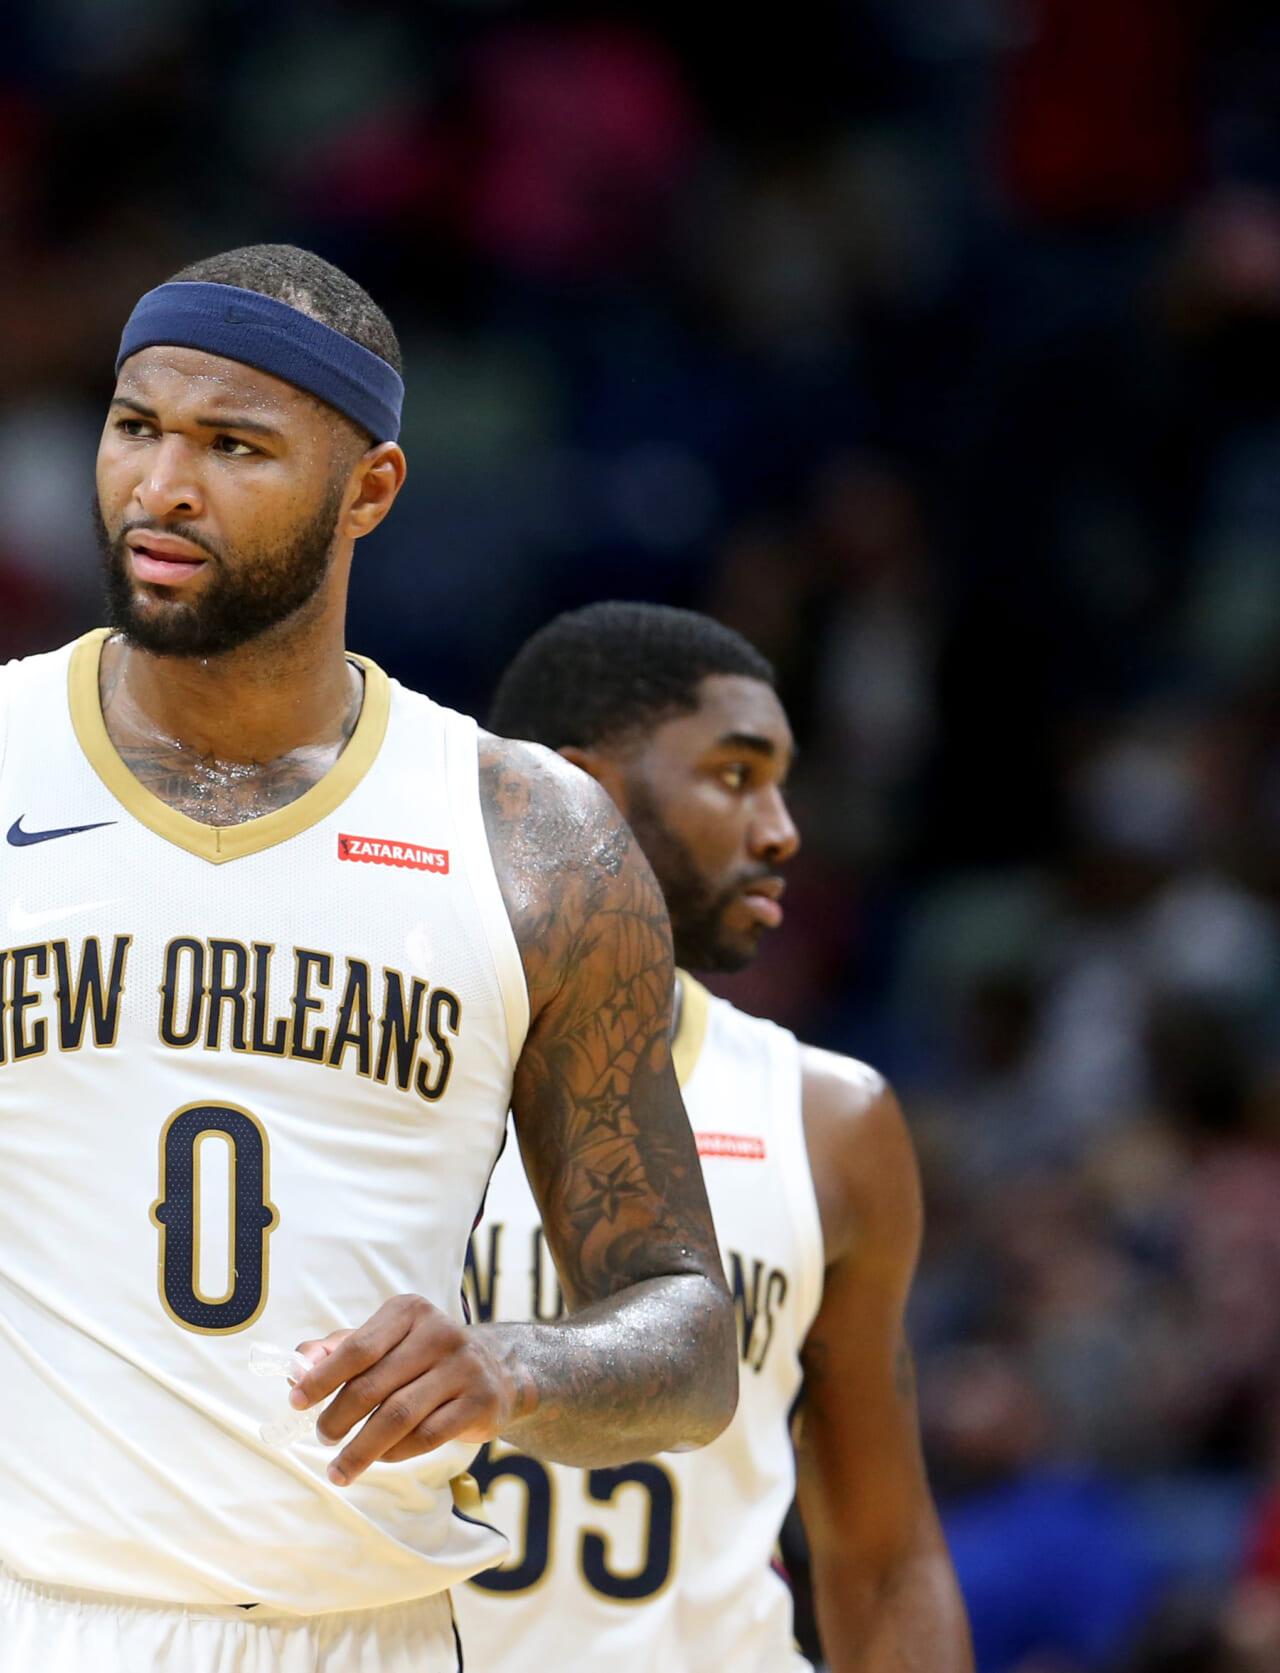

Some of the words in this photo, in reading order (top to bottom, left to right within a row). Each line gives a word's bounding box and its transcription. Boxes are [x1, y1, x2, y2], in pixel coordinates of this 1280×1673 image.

[349, 840, 446, 867] ZATARAIN'S
[158, 937, 462, 1102] ORLEANS
[148, 1099, 280, 1336] 0
